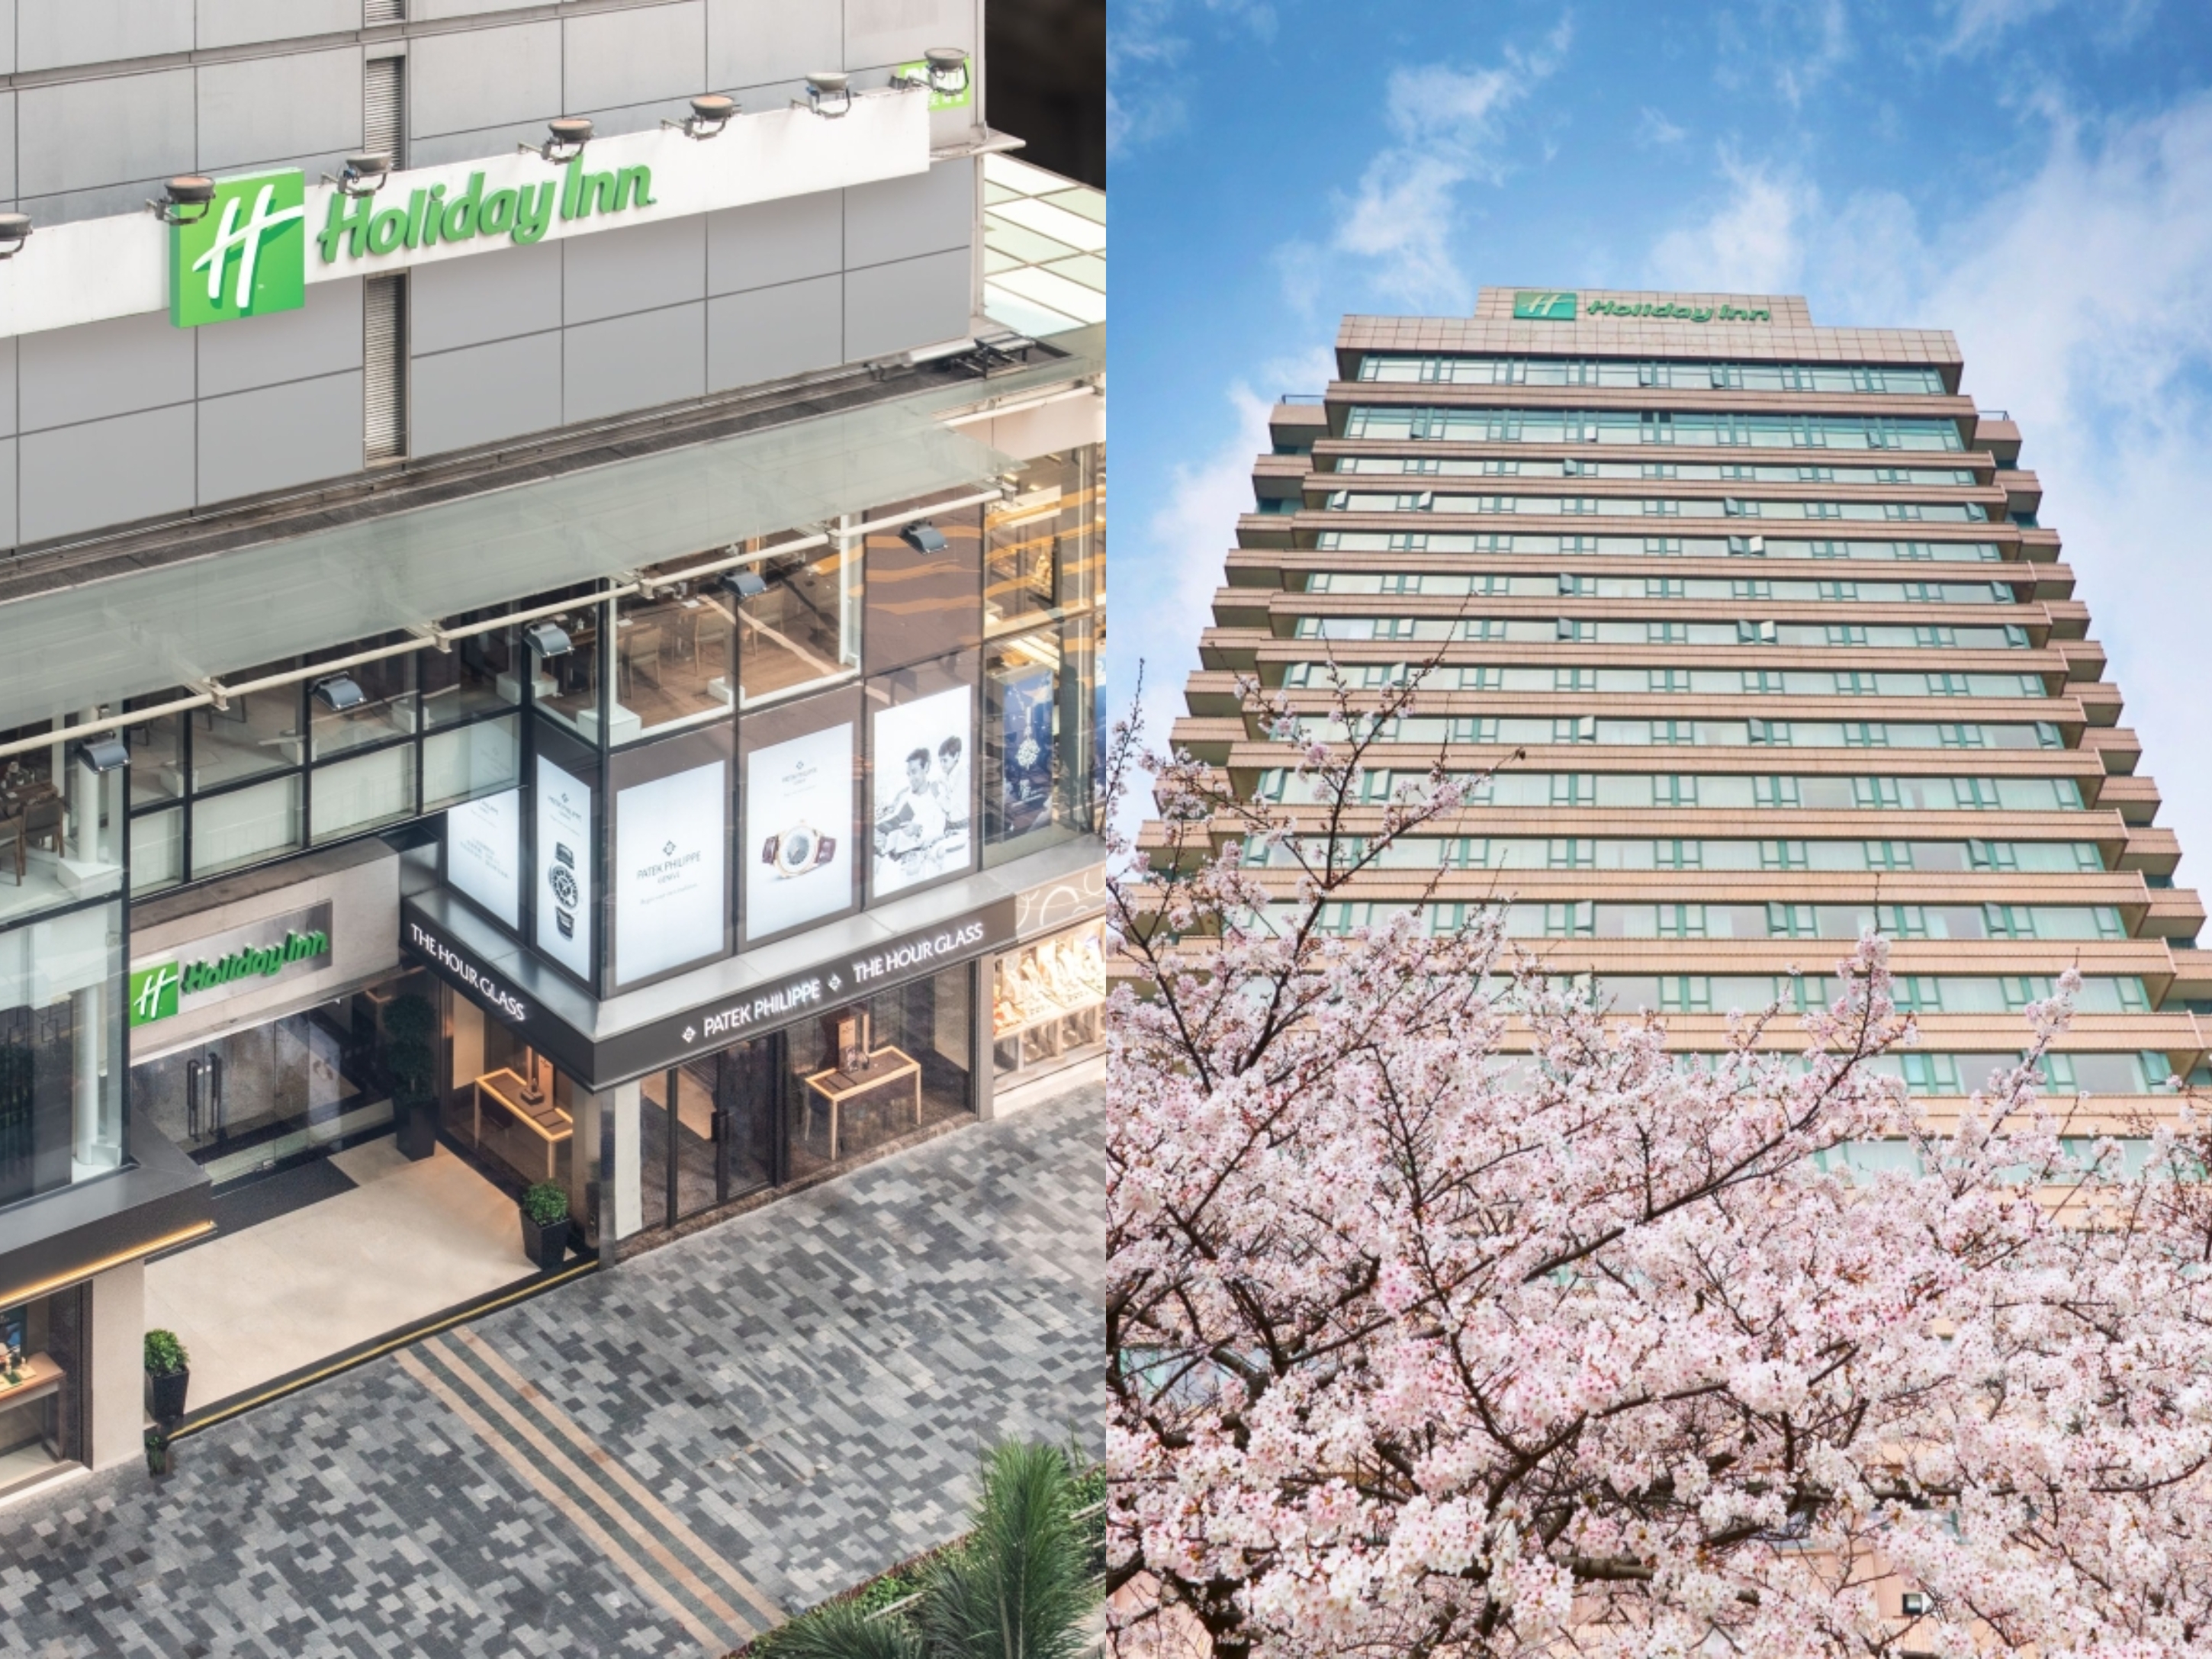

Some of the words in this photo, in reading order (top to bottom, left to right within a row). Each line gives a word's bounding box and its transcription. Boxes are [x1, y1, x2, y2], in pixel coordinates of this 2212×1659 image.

[317, 170, 557, 263] Holiday
[561, 155, 657, 220] Inn
[1587, 300, 1714, 323] Holiday
[1718, 305, 1770, 321] Inn
[181, 943, 285, 995] Holiday
[285, 928, 329, 964] Inn
[410, 922, 436, 956] THE
[438, 944, 479, 989] HOUR
[479, 976, 526, 1022] GLASS
[703, 1004, 752, 1038] PATEK
[753, 978, 821, 1020] PHILIPPE
[853, 956, 884, 983] THE
[886, 940, 933, 972] HOUR
[934, 922, 985, 954] GLASS
